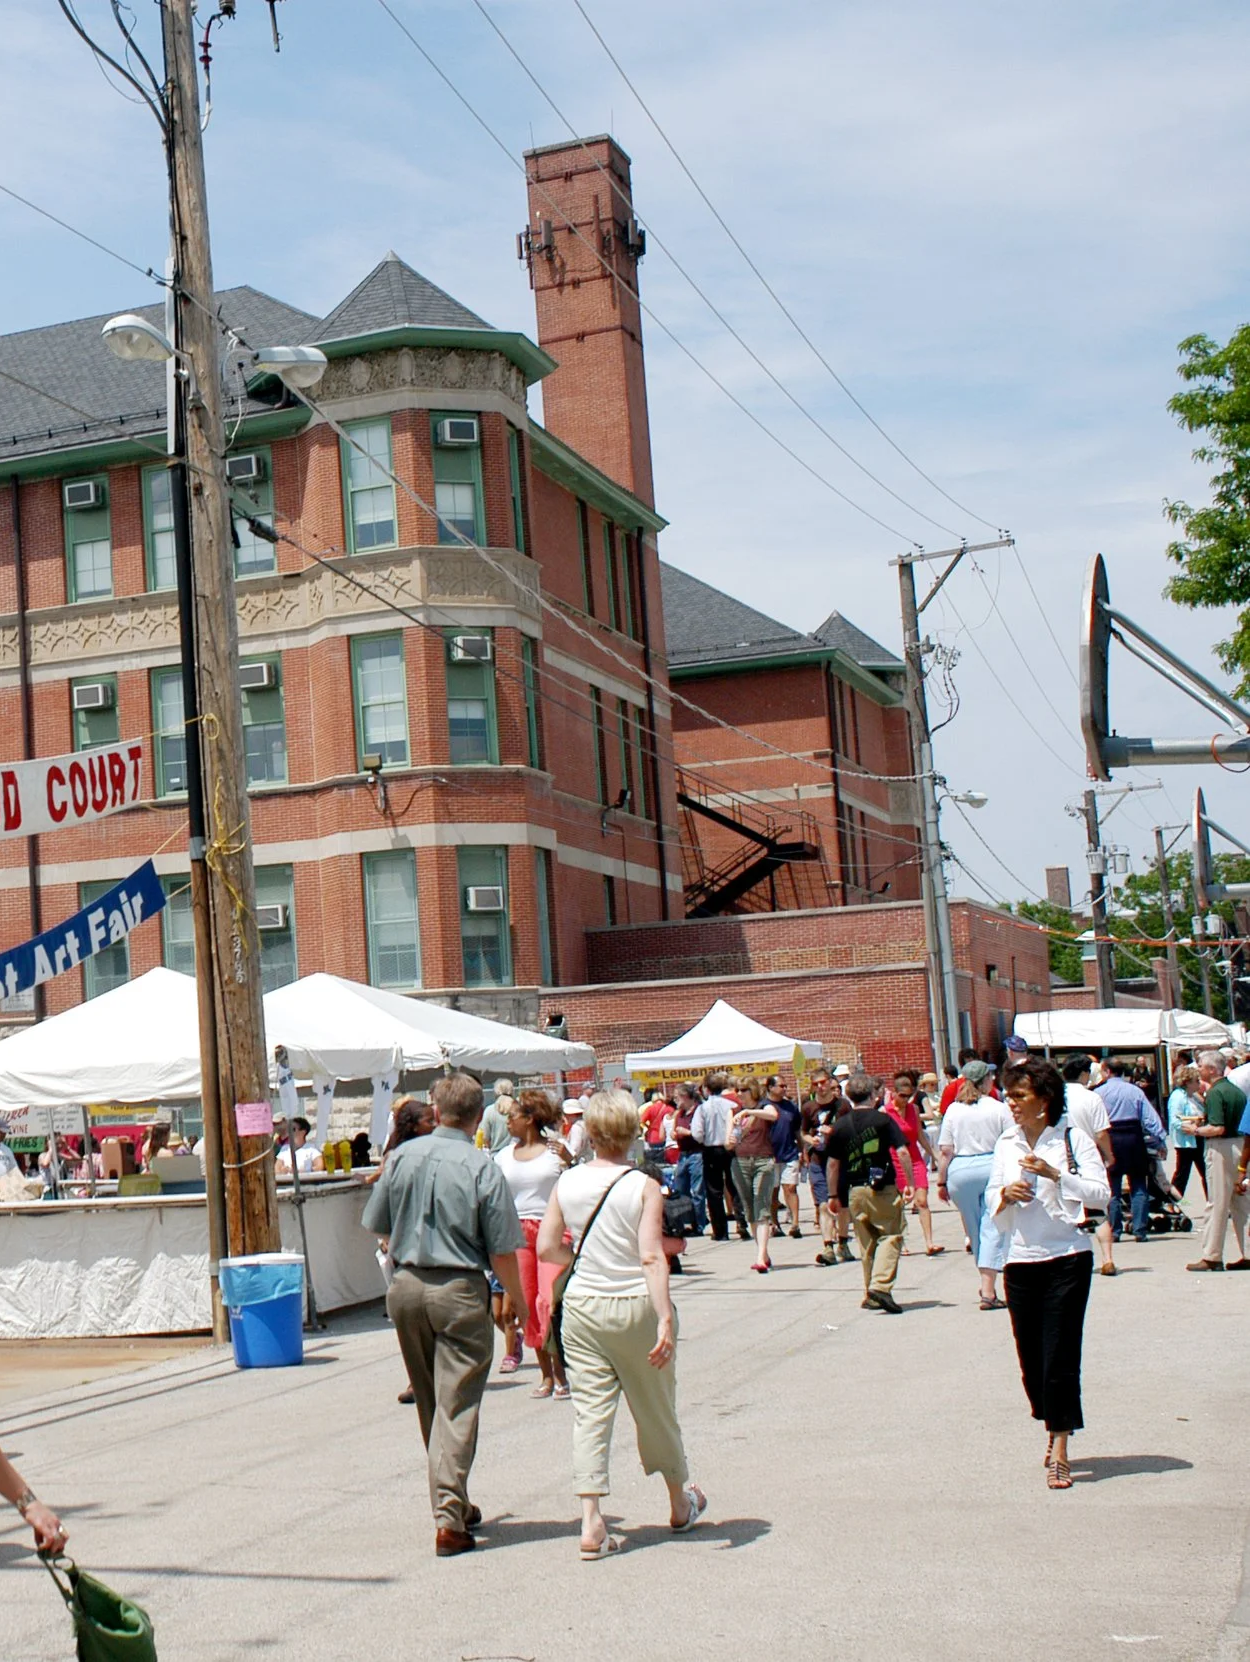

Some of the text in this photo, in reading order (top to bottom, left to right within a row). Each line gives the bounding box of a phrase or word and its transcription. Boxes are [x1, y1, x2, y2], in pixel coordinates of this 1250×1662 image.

[47, 745, 142, 822] COURT
[34, 936, 80, 985] Art
[87, 890, 144, 955] Fair
[662, 1065, 733, 1079] Lemonade
